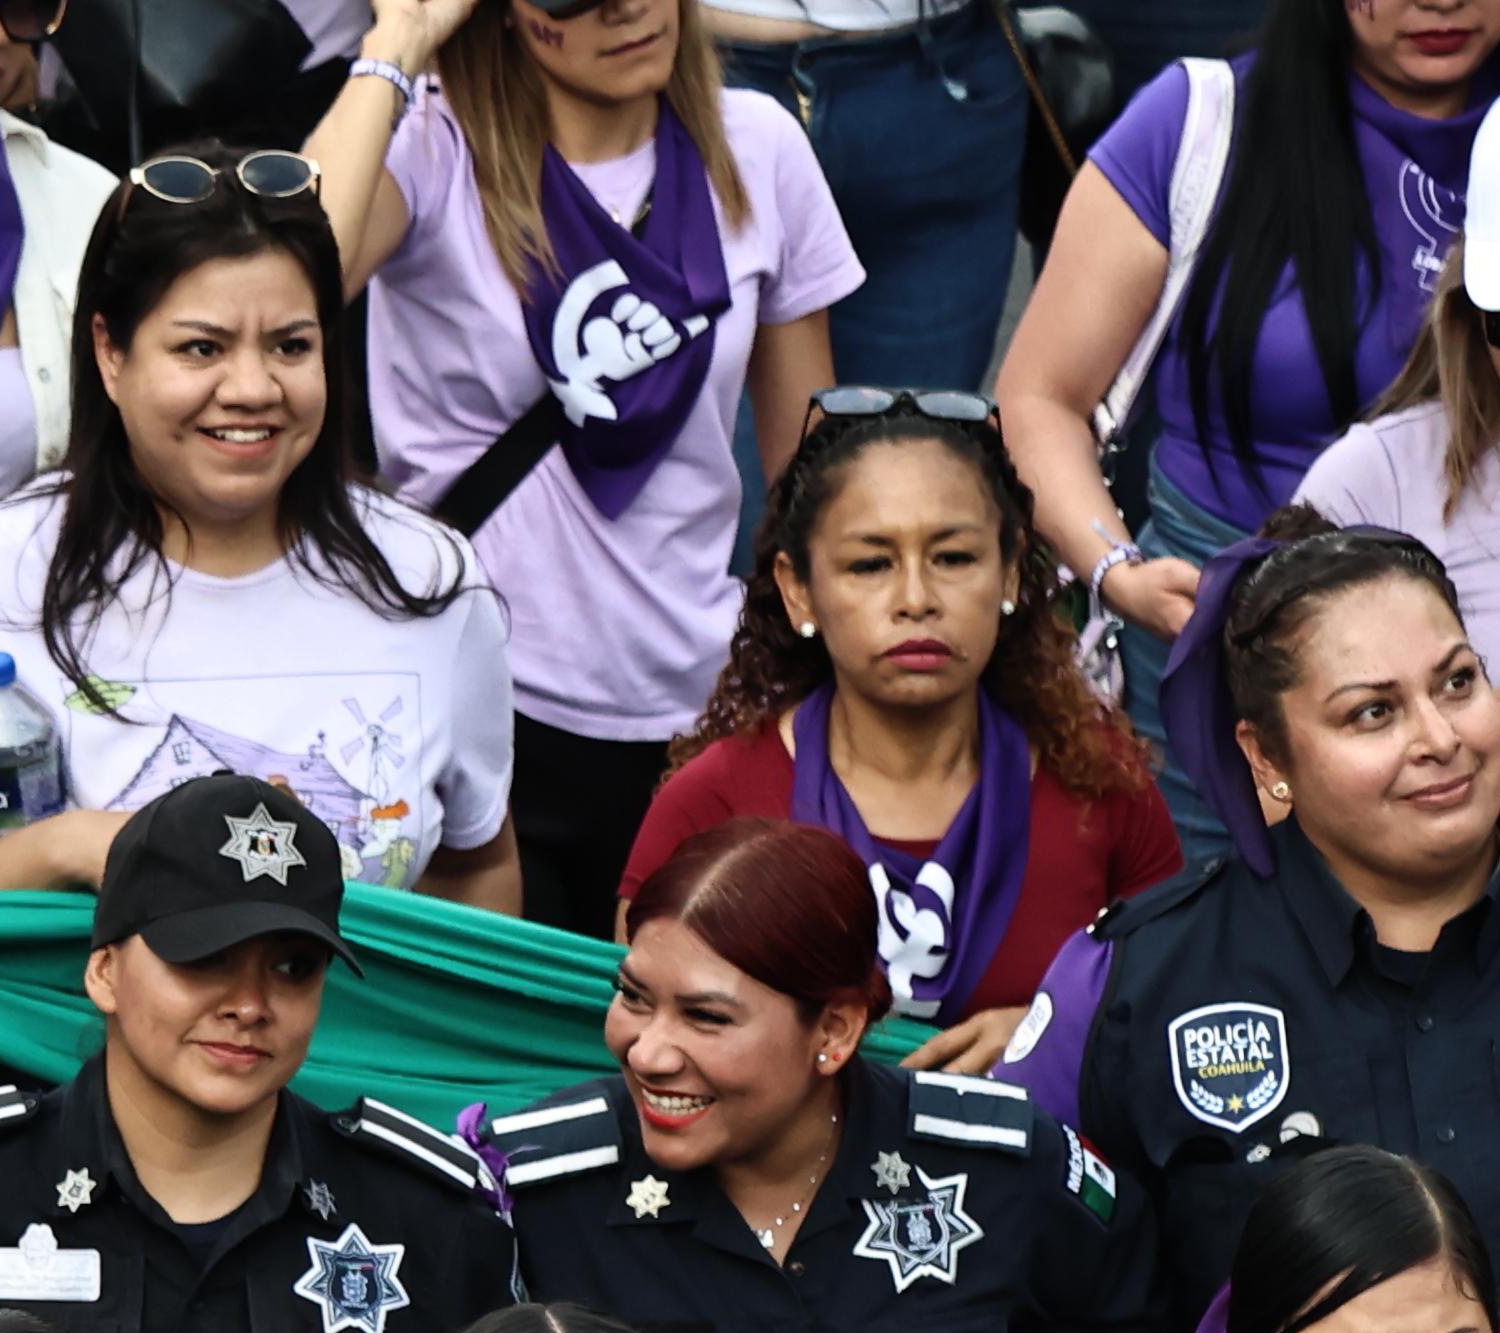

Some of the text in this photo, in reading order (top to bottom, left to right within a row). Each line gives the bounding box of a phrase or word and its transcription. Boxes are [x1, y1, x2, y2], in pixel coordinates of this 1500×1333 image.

[1184, 1017, 1271, 1050] POLICÍA
[1187, 1040, 1274, 1068] ESTATAL
[1198, 1060, 1265, 1079] COAHUILA
